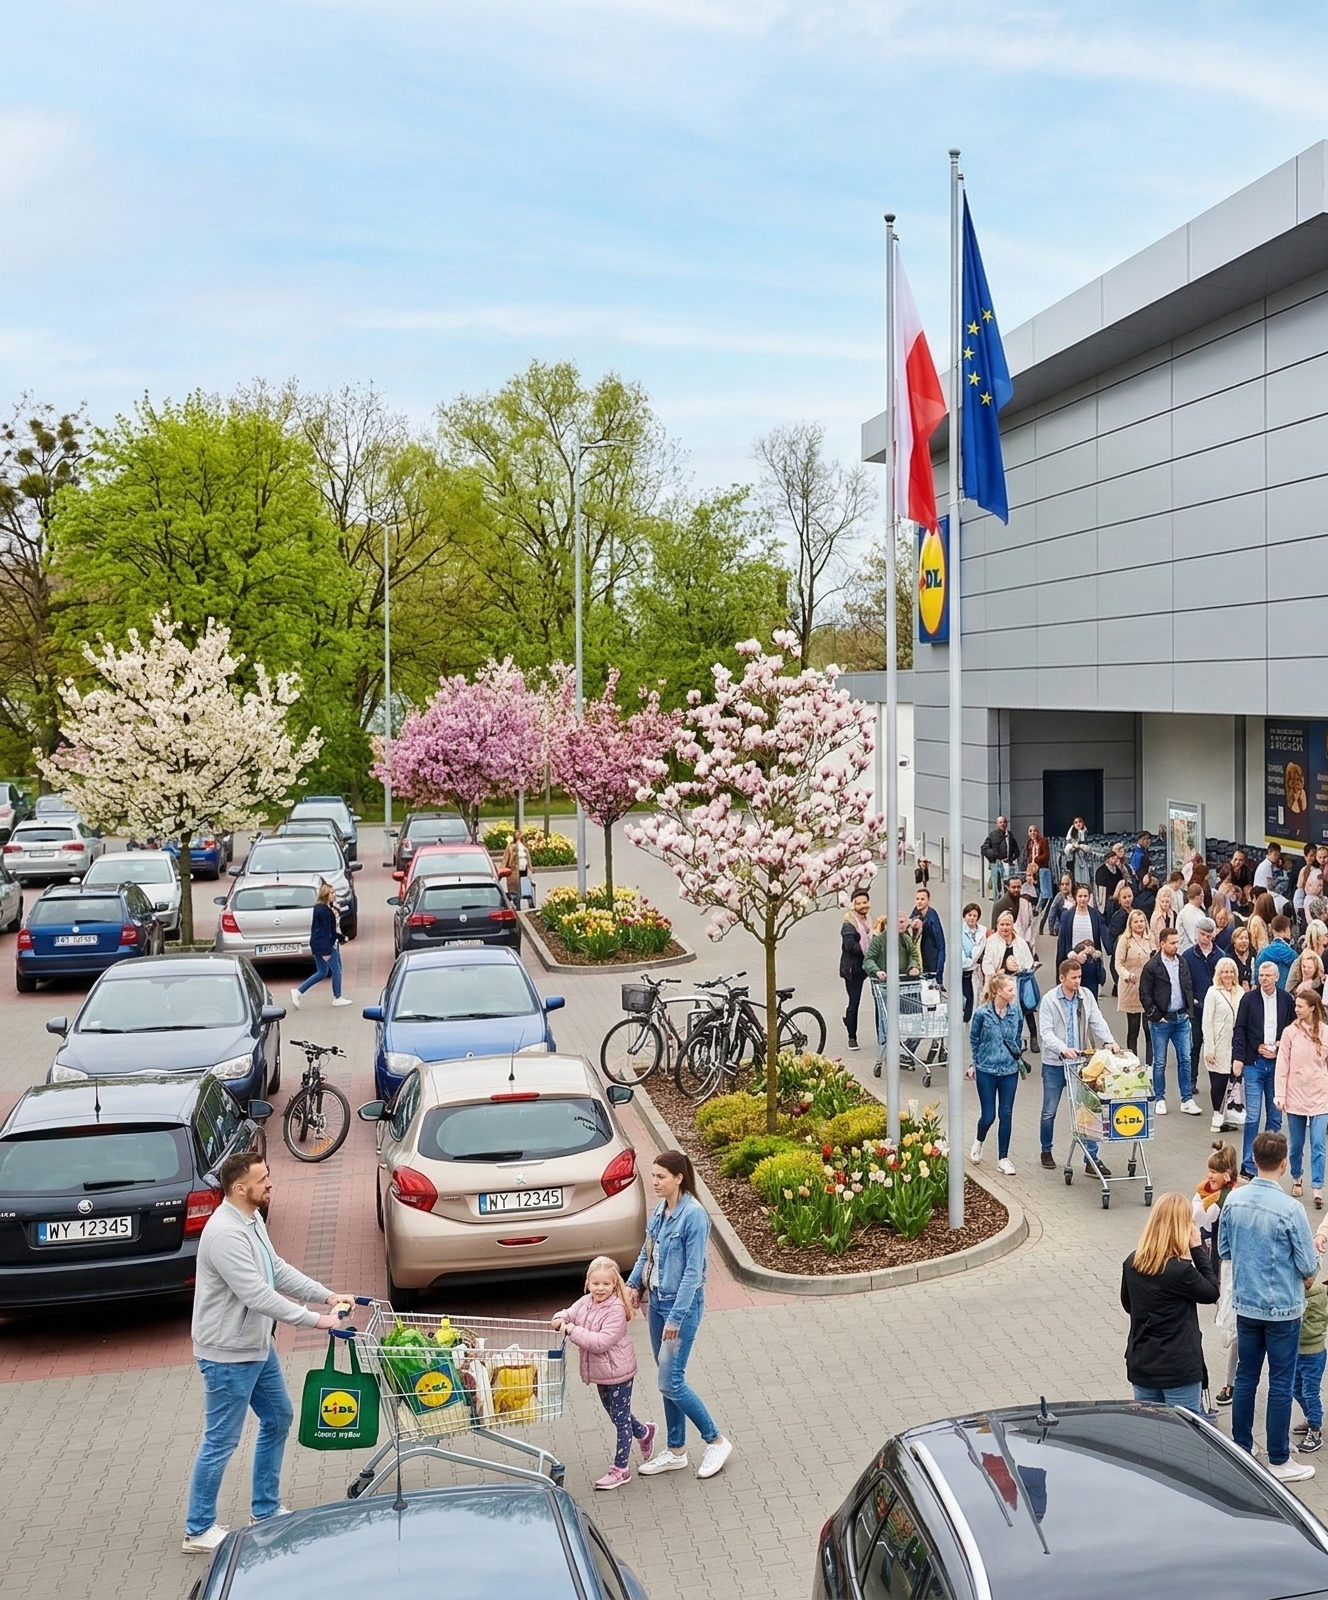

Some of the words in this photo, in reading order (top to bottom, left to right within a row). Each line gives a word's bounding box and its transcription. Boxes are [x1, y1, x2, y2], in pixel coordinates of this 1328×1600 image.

[516, 1190, 559, 1207] 12345
[49, 1222, 71, 1240] WY
[79, 1218, 129, 1237] 12345
